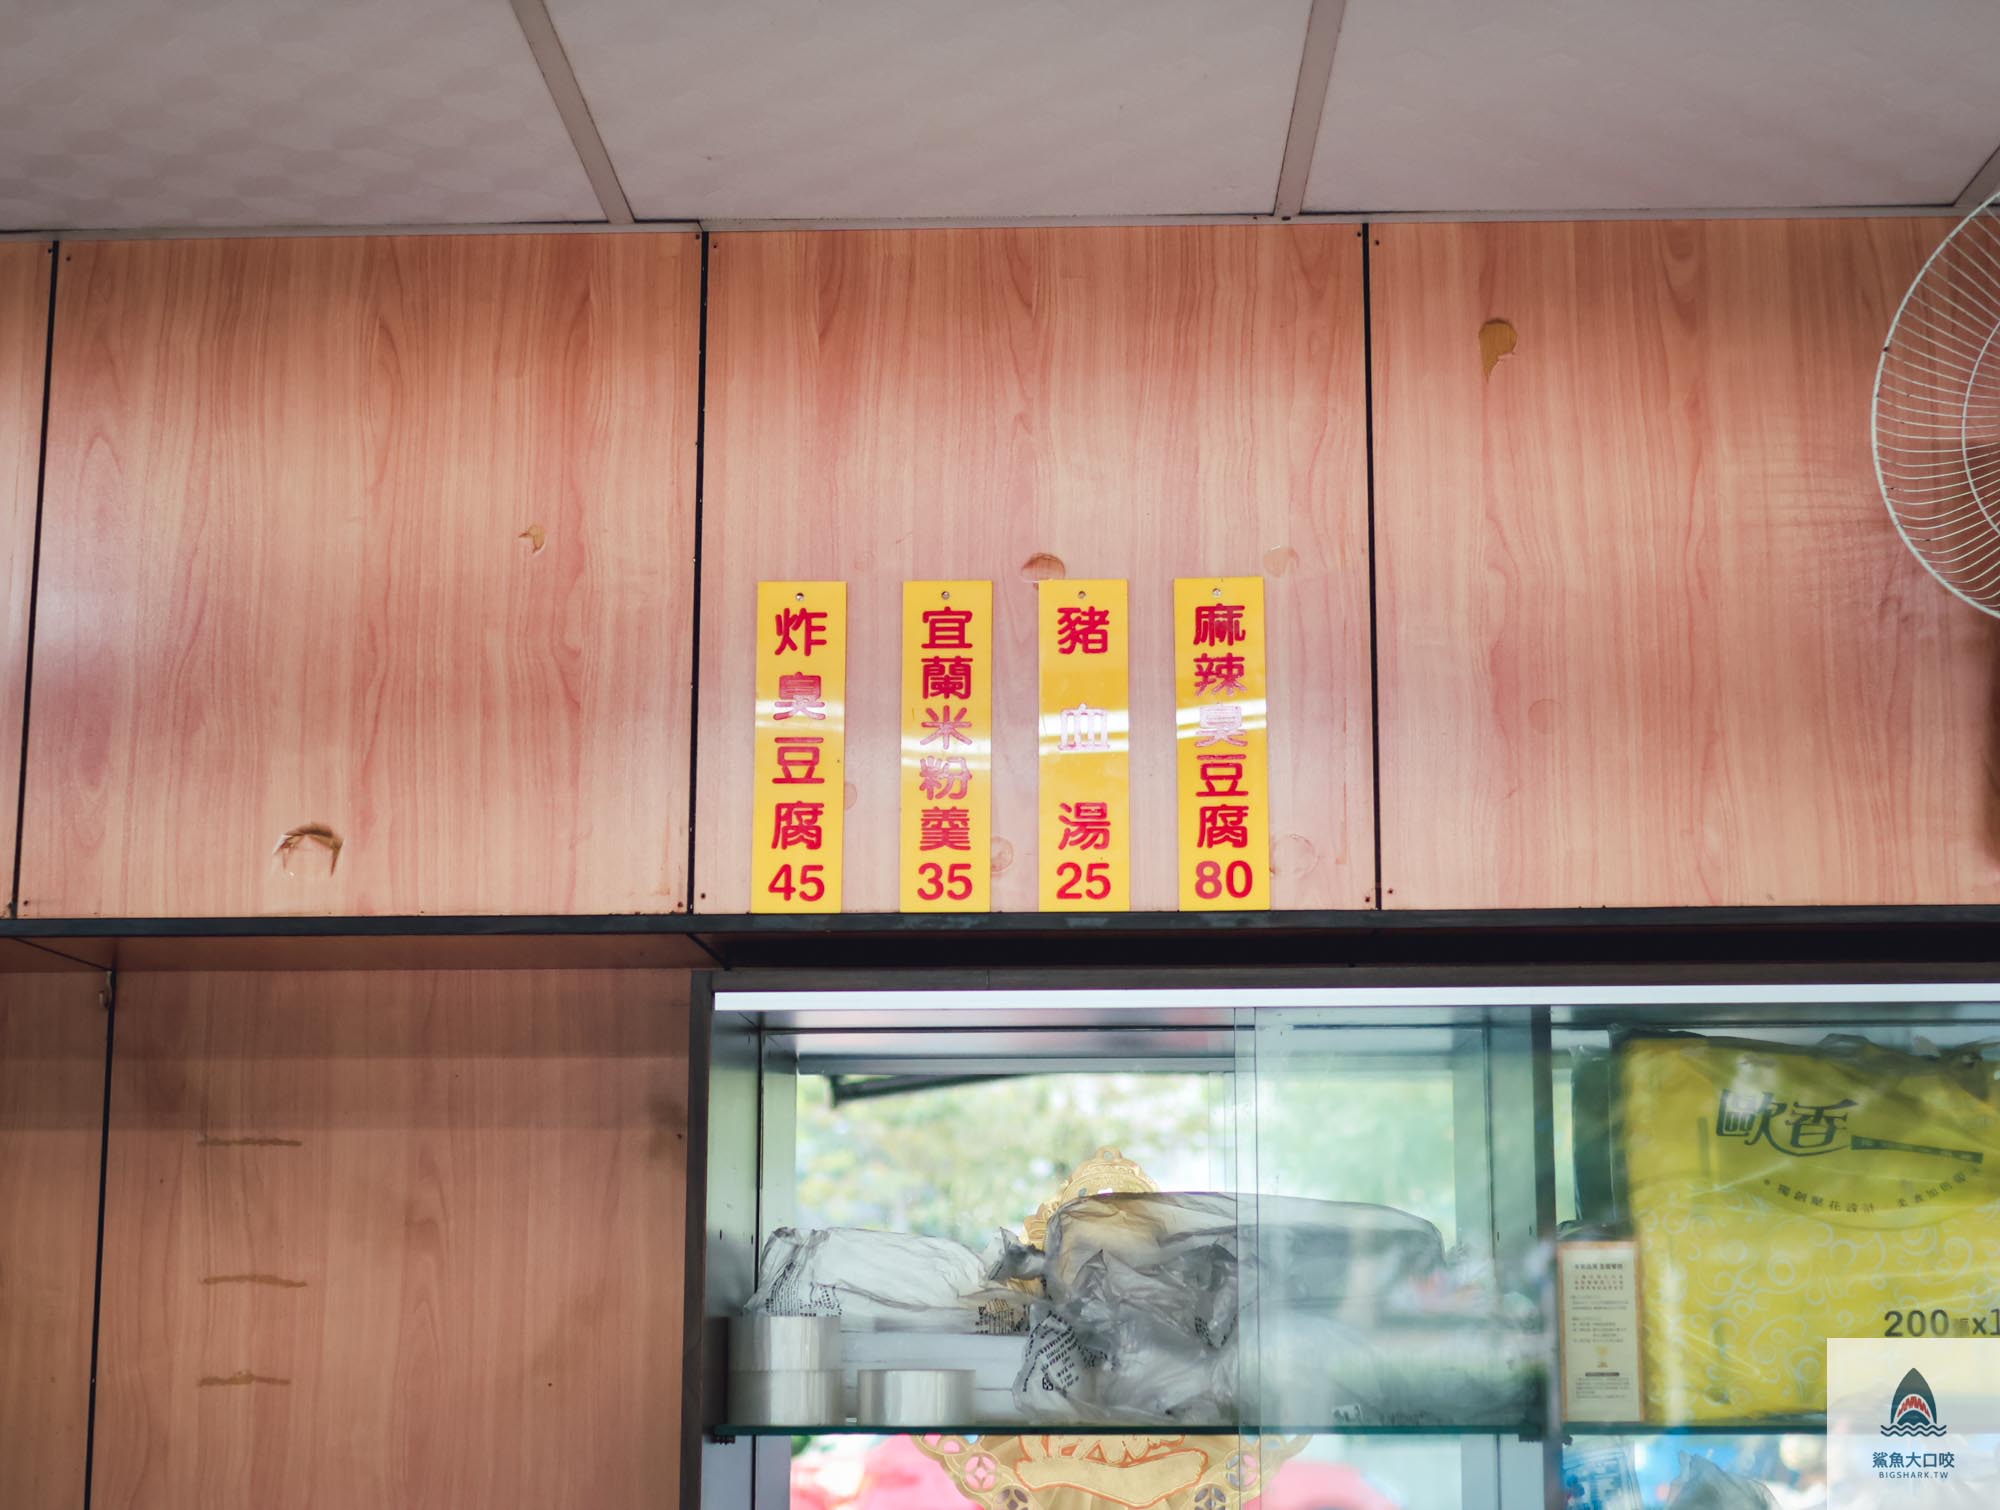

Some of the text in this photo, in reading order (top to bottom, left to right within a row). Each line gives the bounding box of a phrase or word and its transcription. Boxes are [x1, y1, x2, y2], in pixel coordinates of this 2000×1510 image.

[768, 607, 828, 902] 炸臭豆腐 45
[917, 606, 974, 901] 宜蘭米粉羹 35
[1056, 606, 1112, 900] 豬血湯 25
[1192, 603, 1253, 899] 麻辣臭豆腐 80
